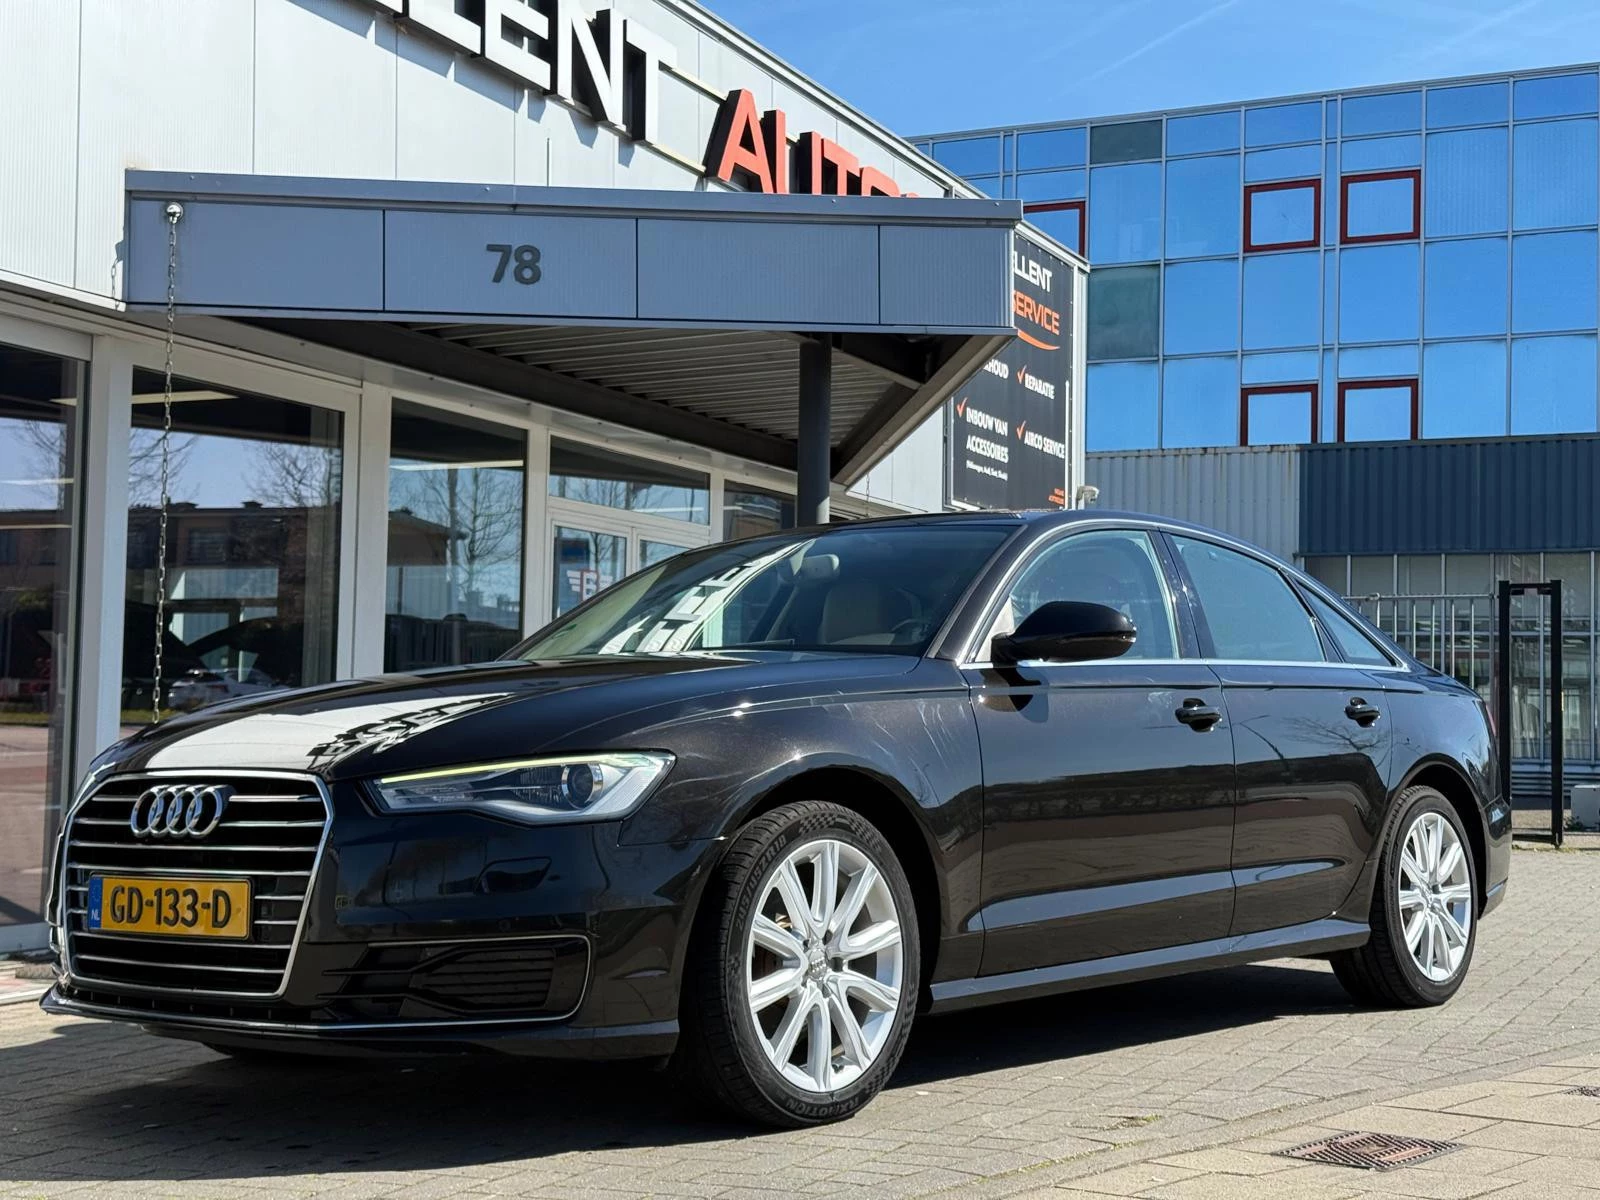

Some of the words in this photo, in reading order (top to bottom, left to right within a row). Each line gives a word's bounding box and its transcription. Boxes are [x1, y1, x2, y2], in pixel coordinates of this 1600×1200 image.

[486, 244, 542, 285] 78
[1024, 373, 1055, 400] REPARATIE
[966, 407, 995, 431] INBOUW
[994, 417, 1009, 437] VAN
[966, 435, 1009, 464] ACCESSOIRES
[1024, 430, 1043, 451] AIRCO
[1042, 437, 1066, 460] SERVICE
[91, 908, 101, 921] NL
[110, 885, 232, 929] GD-133-D
